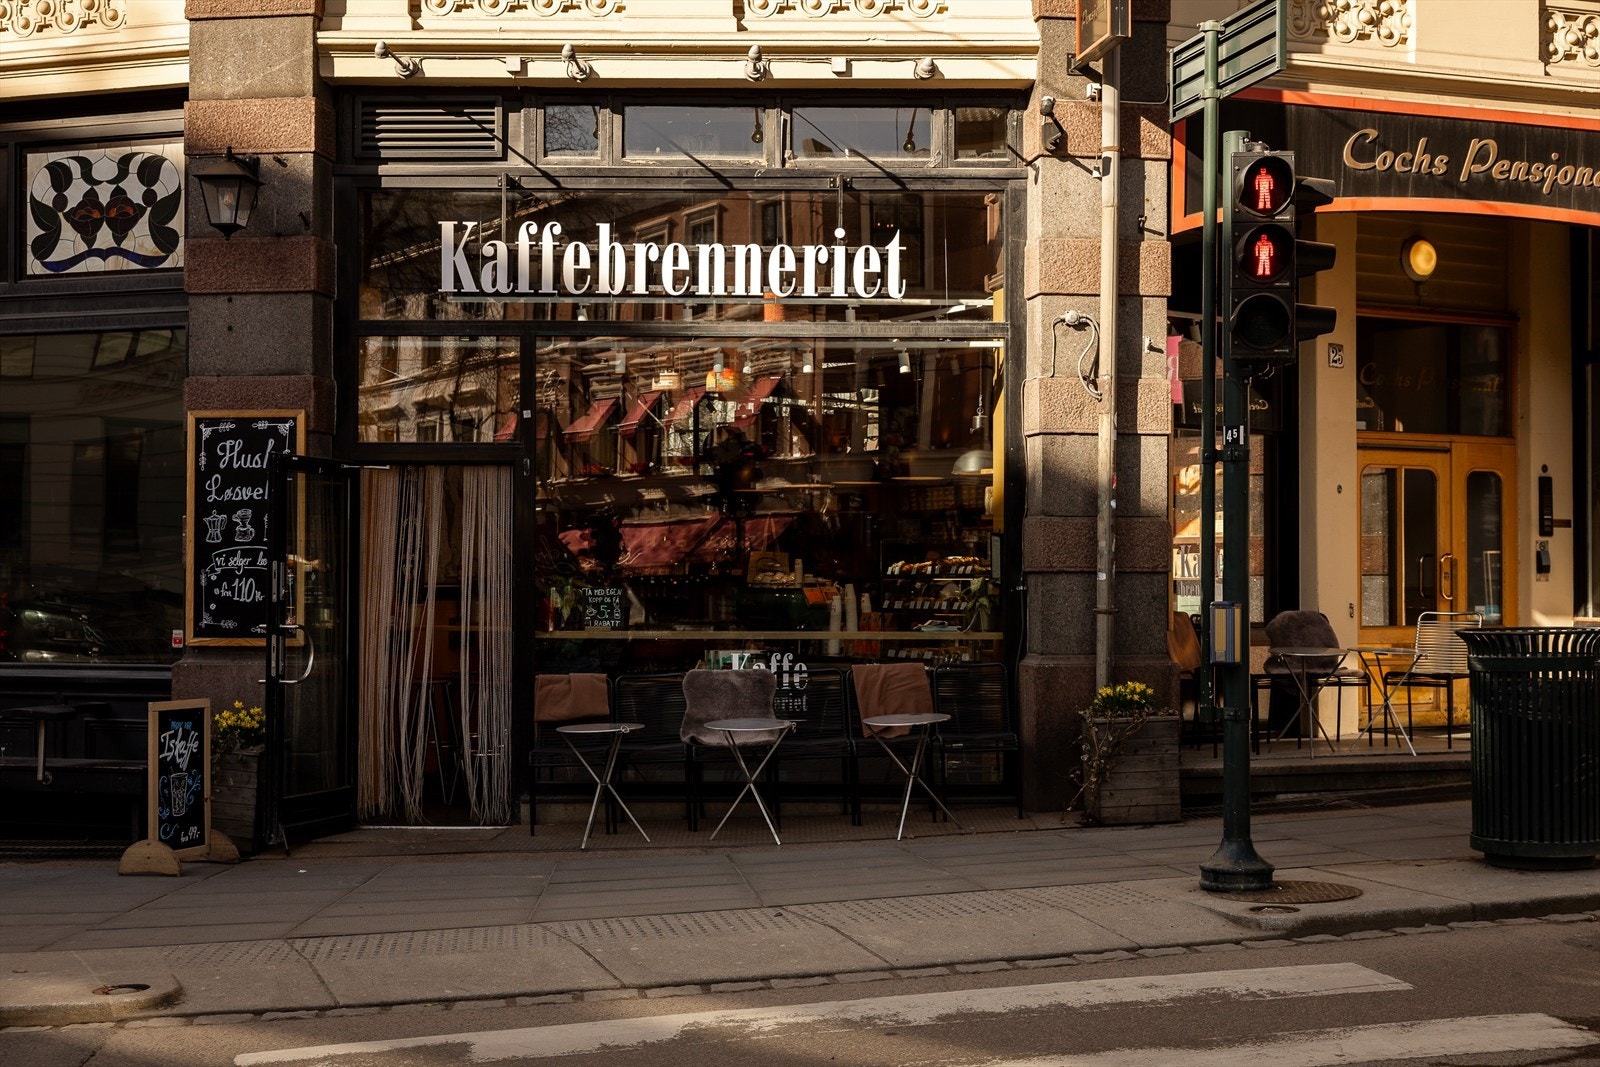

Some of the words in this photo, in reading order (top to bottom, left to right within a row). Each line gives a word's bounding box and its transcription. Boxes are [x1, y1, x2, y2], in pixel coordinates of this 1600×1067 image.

[1343, 128, 1450, 175] Cochs
[437, 220, 908, 299] Kaffebrenneriet
[1331, 347, 1343, 365] 25
[1226, 428, 1238, 442] 45
[228, 550, 252, 575] selger
[231, 577, 255, 603] 110
[582, 587, 593, 596] TA
[594, 588, 605, 596] MED
[606, 588, 622, 596] EGEN
